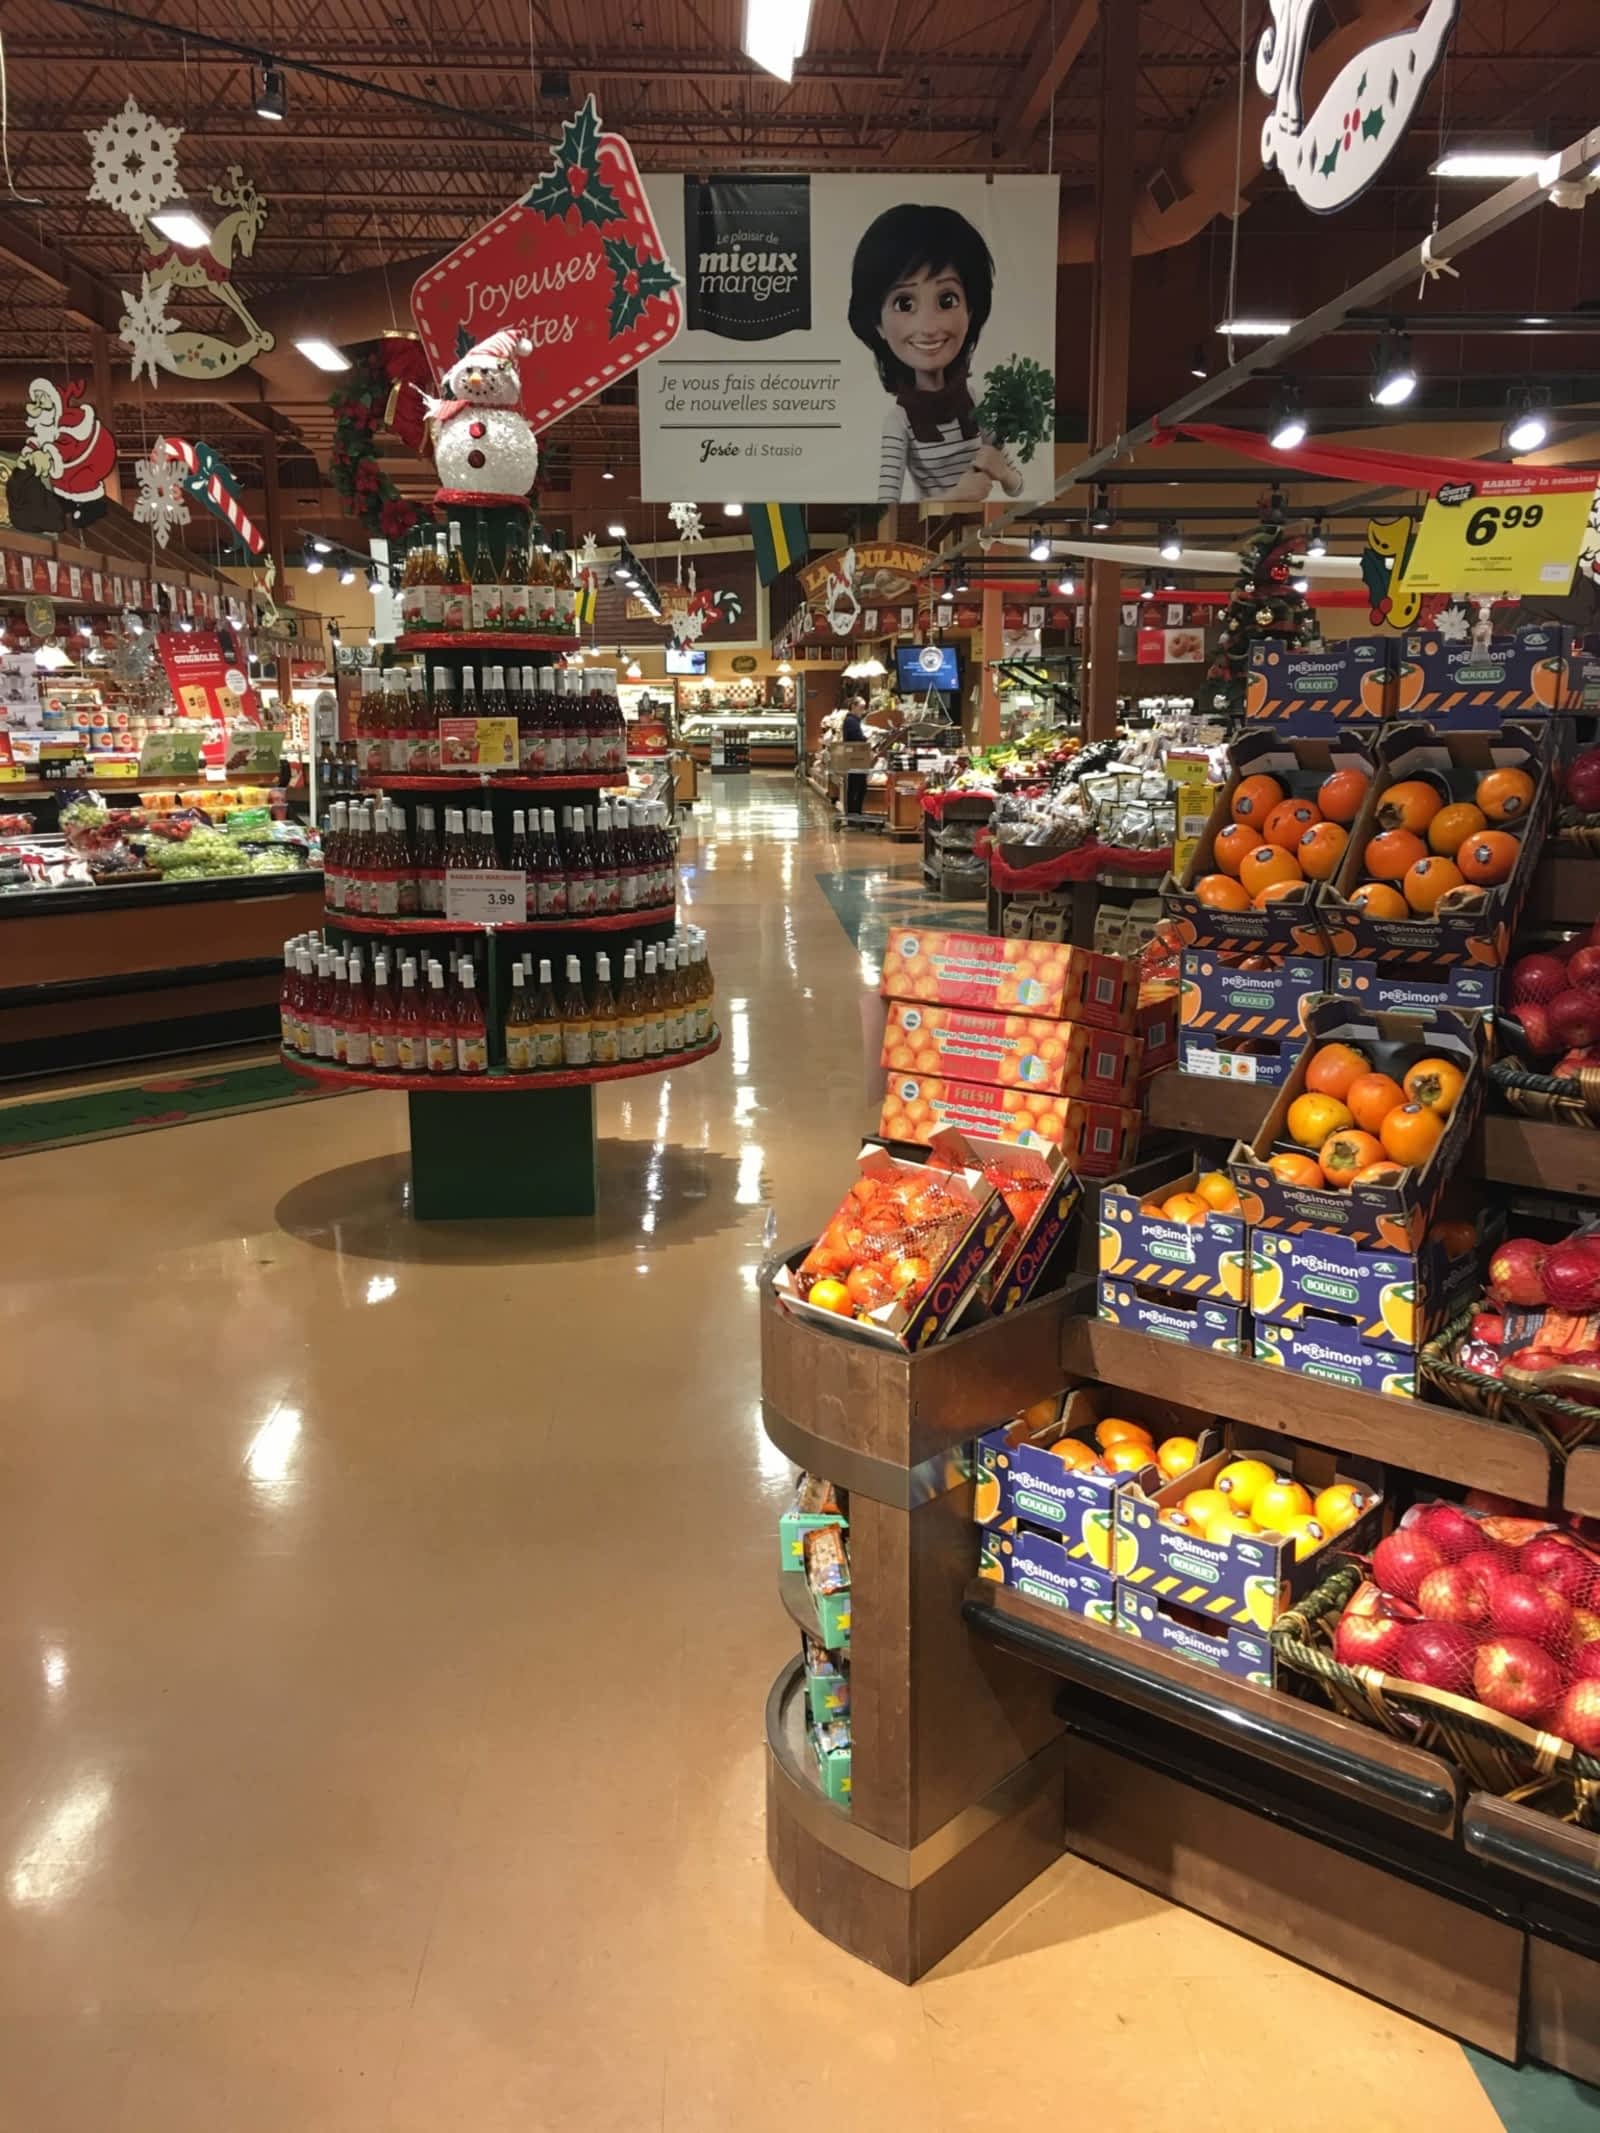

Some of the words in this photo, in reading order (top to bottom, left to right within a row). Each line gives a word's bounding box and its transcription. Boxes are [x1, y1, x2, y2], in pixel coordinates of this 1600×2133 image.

[716, 232, 729, 245] Le
[730, 229, 763, 245] plaisir
[765, 231, 779, 244] de
[699, 244, 798, 273] mieux
[459, 252, 602, 325] Joyeuses
[699, 273, 798, 301] manger
[659, 375, 677, 393] Je
[682, 378, 720, 391] vous
[723, 374, 756, 394] fais
[760, 374, 840, 391] découvrir
[665, 395, 685, 411] de
[690, 394, 768, 411] nouvelles
[772, 397, 836, 411] saveurs
[700, 439, 740, 463] Josée
[745, 442, 758, 456] di
[761, 444, 803, 457] Stasio
[1524, 478, 1536, 487] de
[1539, 477, 1549, 486] la
[805, 565, 831, 591] LA
[1460, 669, 1500, 680] BOUQUET
[1298, 681, 1334, 690] BOUQUET
[488, 893, 515, 905] 3.99
[1231, 995, 1270, 1007] BOUQUET
[955, 1087, 995, 1105] FRESH
[1300, 1207, 1344, 1221] BOUQUET
[1306, 1279, 1354, 1299] BOUQUET
[1020, 1495, 1060, 1518] BOUQUET
[1172, 1558, 1217, 1580] BOUQUET
